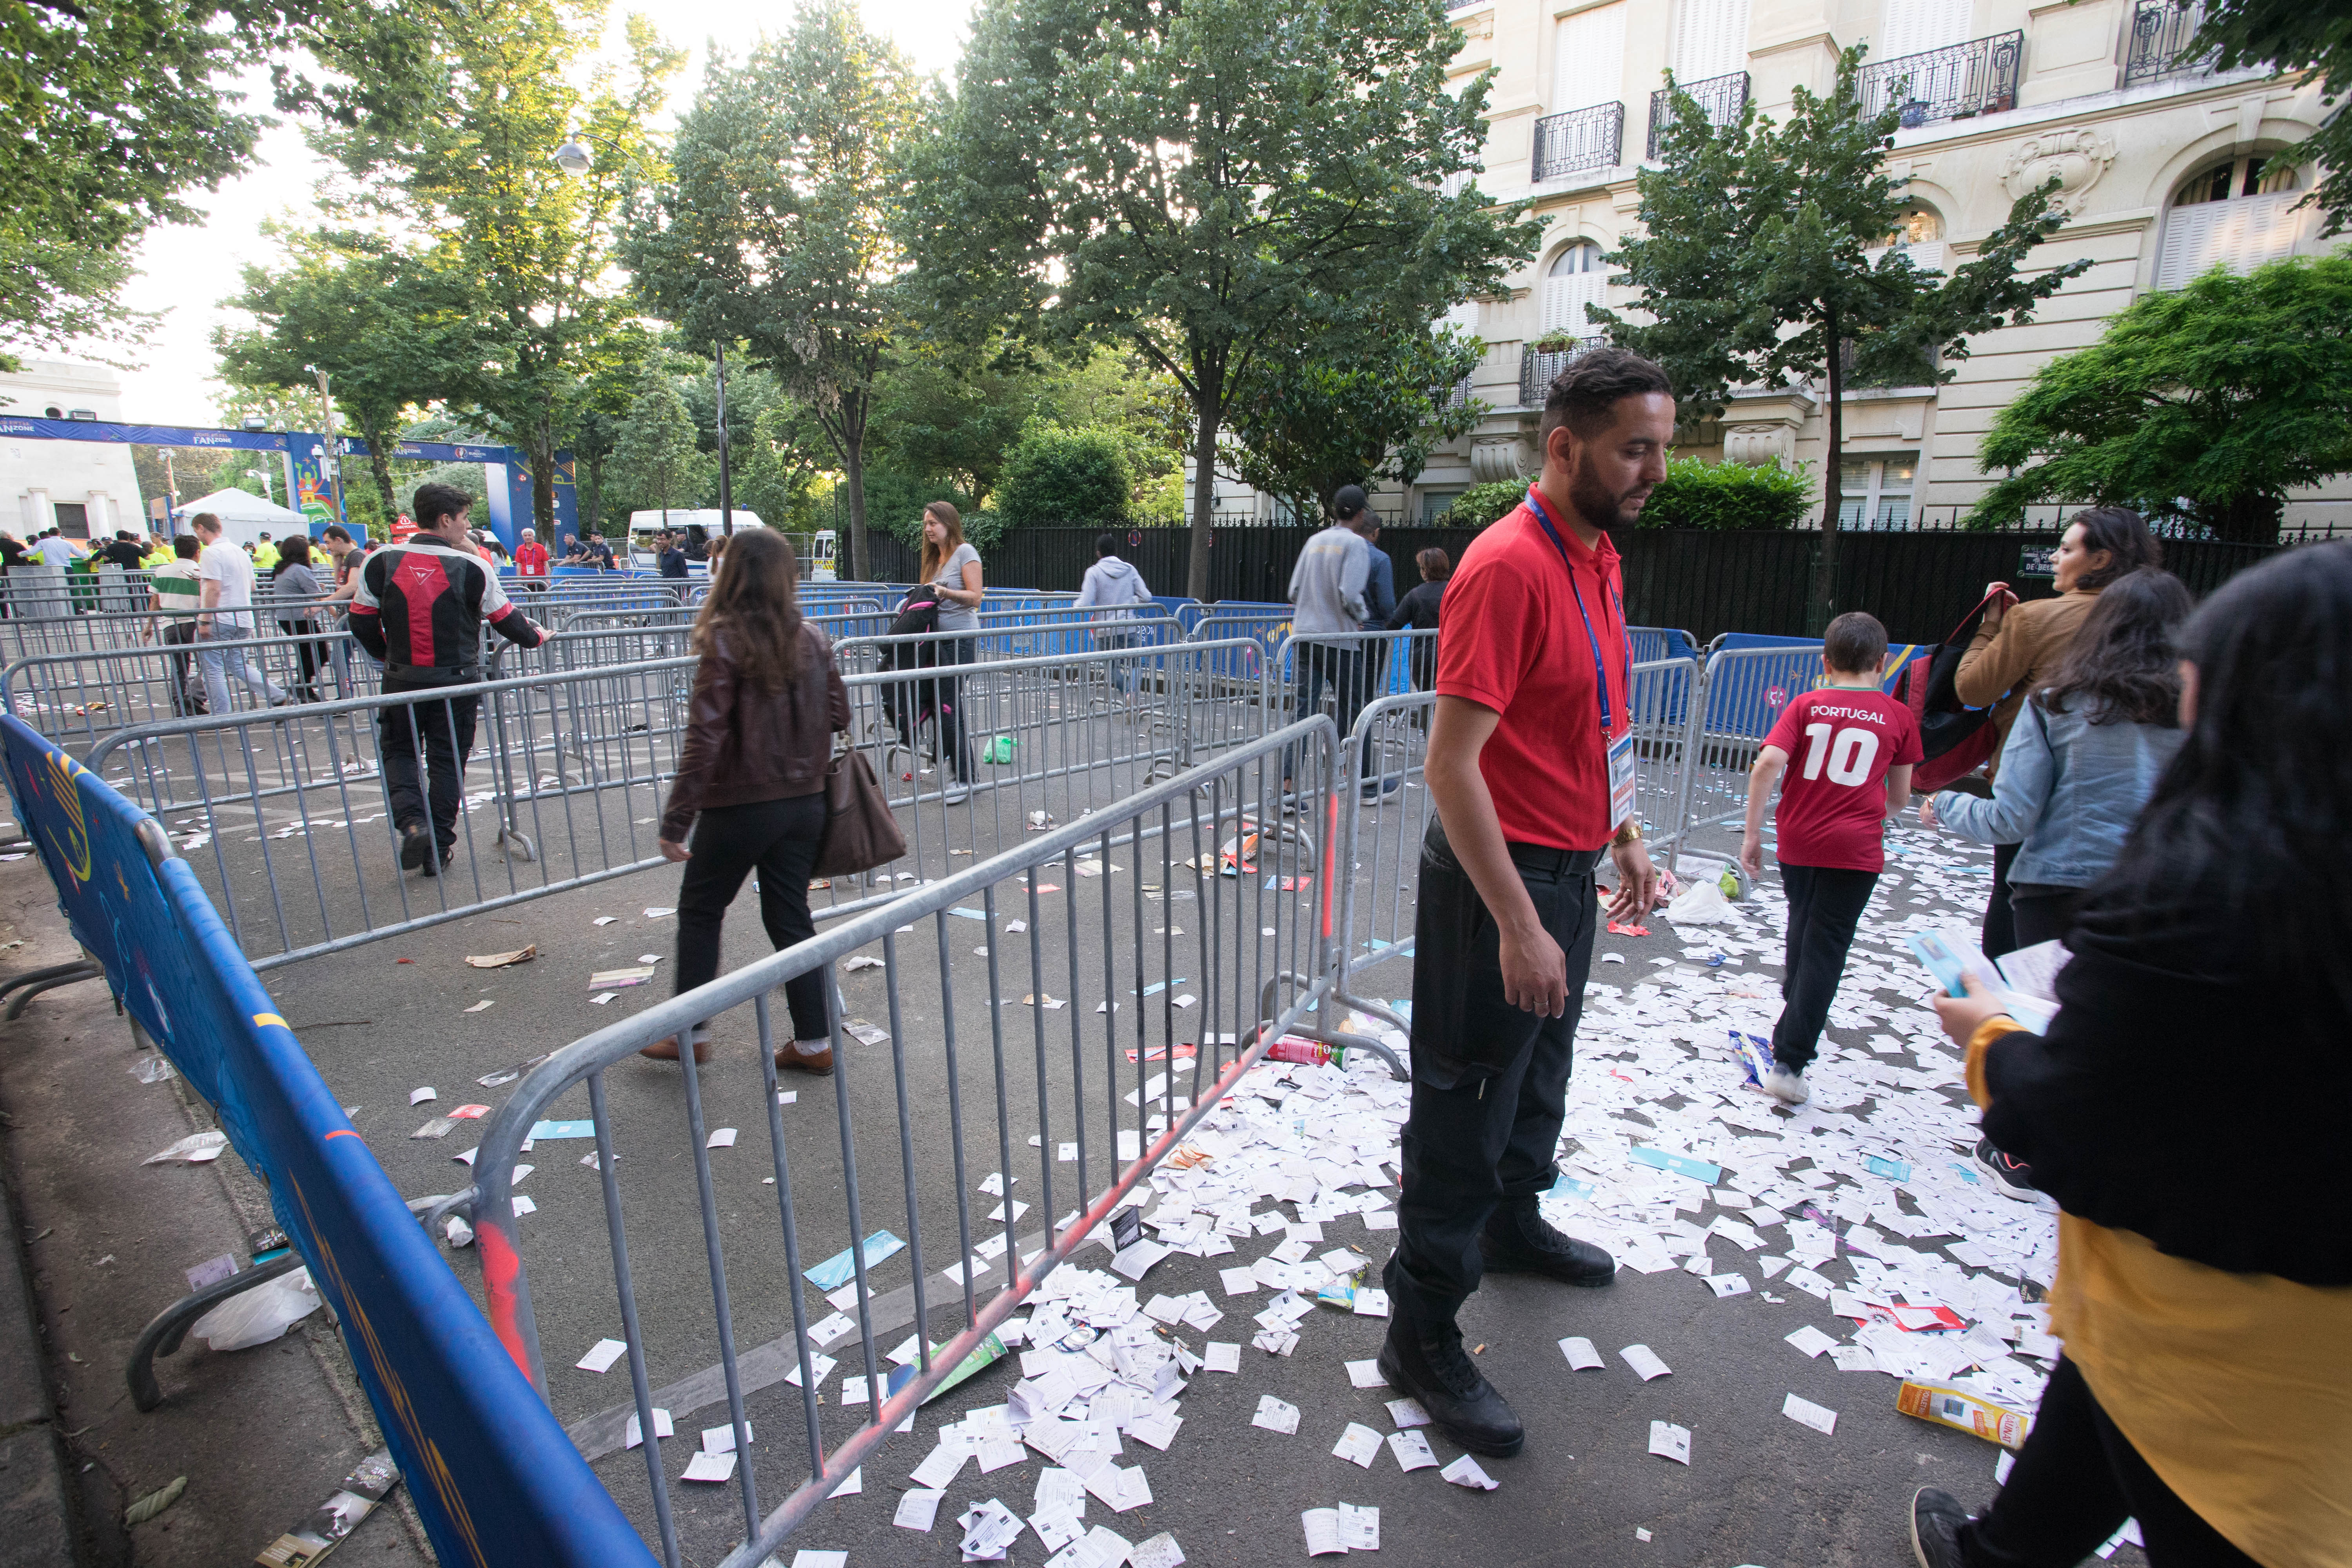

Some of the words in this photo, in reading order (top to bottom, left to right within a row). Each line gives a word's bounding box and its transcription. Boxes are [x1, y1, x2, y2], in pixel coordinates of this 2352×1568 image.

[1811, 705, 1886, 725] PORTUGAL
[1803, 723, 1879, 787] 10
[2002, 1414, 2015, 1444] DAUNAT
